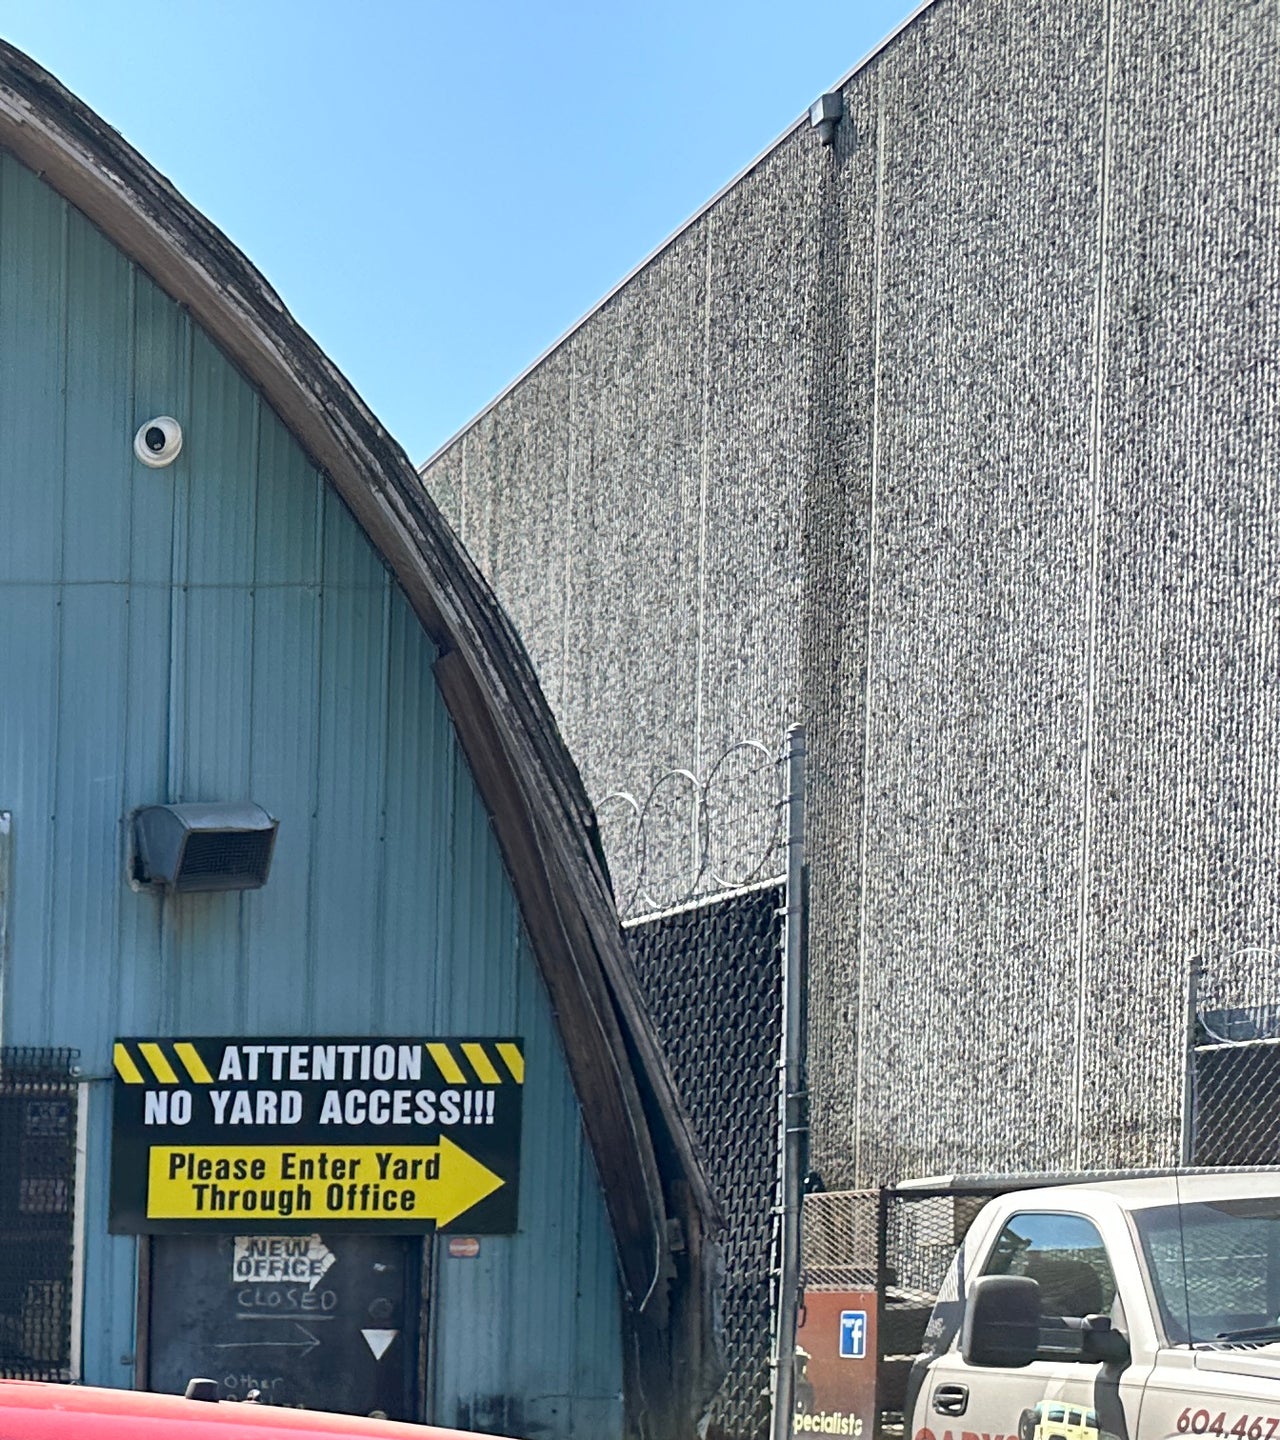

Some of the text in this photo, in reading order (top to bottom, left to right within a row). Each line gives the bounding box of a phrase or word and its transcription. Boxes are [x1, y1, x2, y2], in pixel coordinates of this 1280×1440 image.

[218, 1044, 422, 1081] ATTENTION
[144, 1089, 496, 1125] NO YARD ACCESS!!!
[168, 1152, 441, 1180] Please Enter Yard
[191, 1183, 416, 1216] Through Office
[250, 1239, 309, 1257] NEW
[236, 1258, 322, 1277] OFFICE
[237, 1288, 337, 1311] CLOSED
